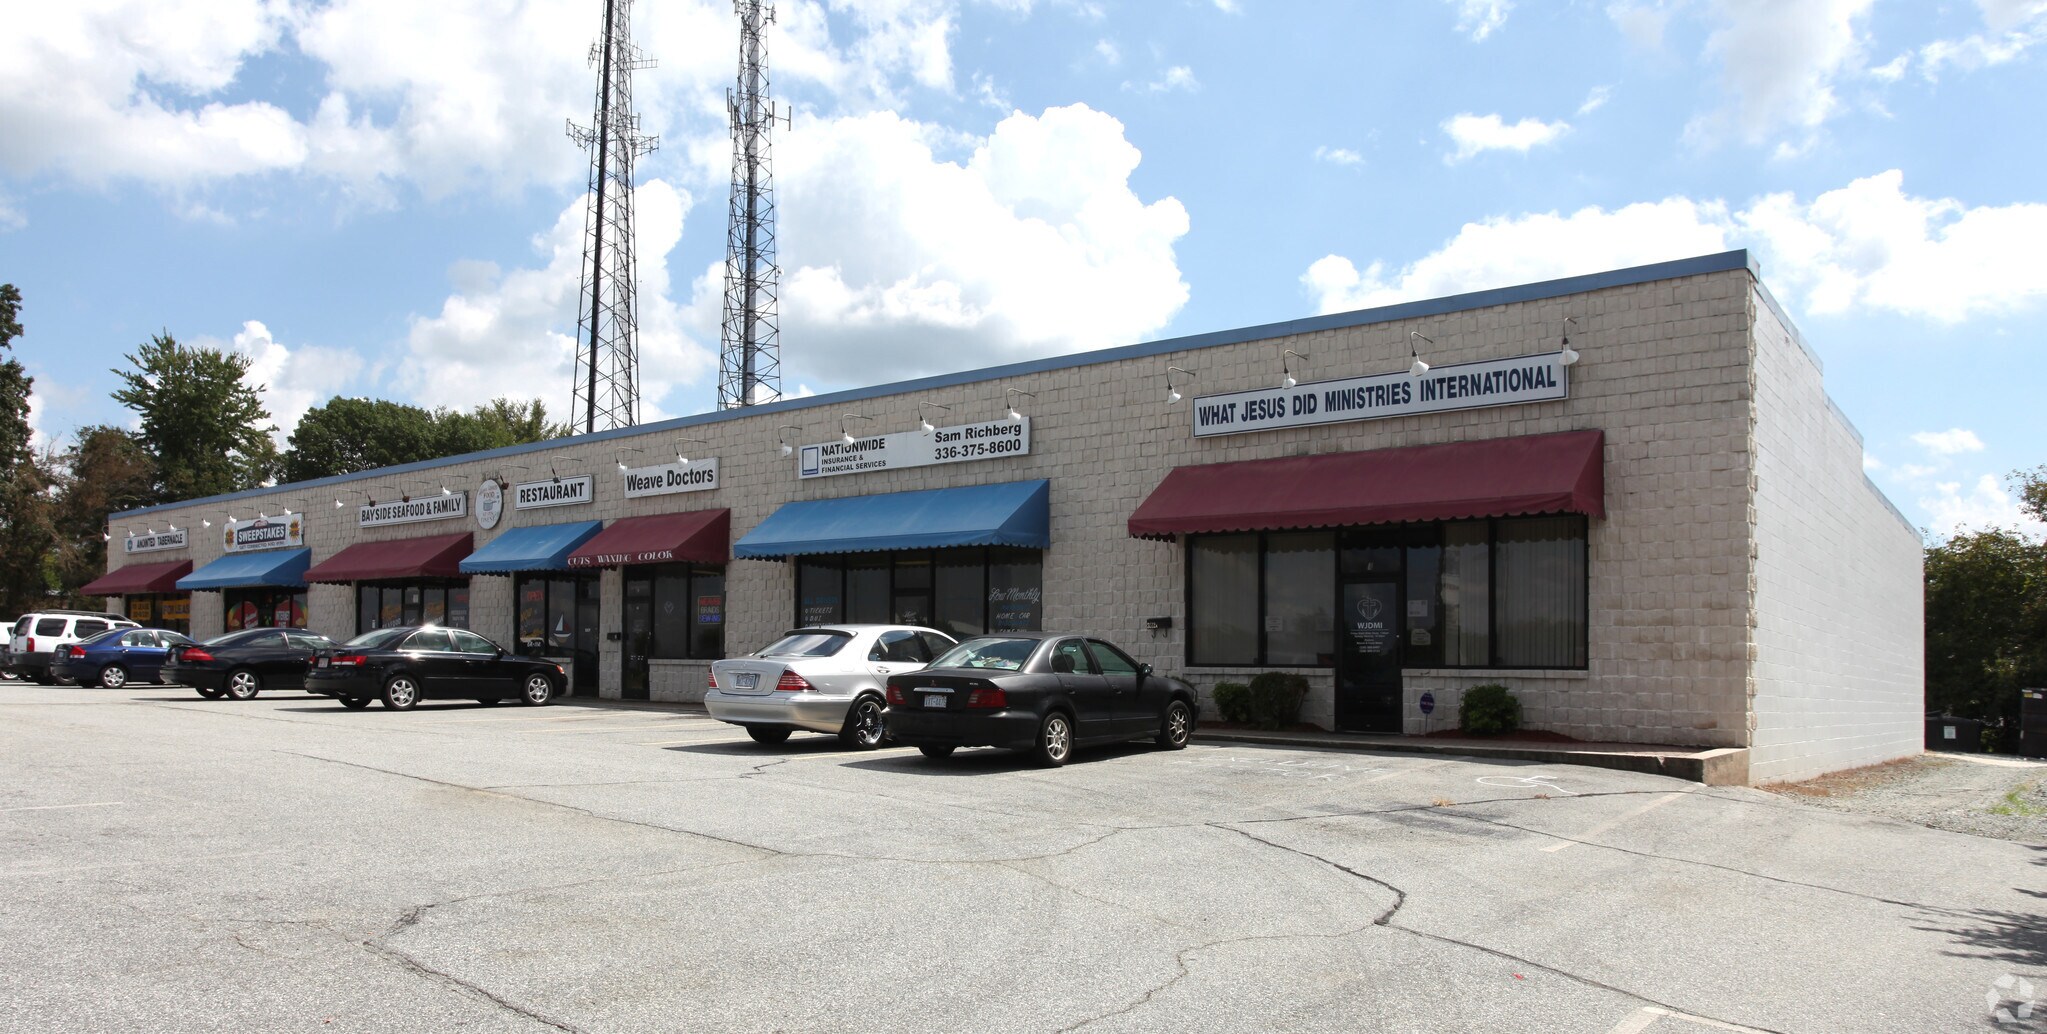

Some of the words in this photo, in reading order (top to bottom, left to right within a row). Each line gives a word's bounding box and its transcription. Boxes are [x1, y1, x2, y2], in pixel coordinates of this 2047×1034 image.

[1199, 403, 1236, 427] WHAT
[1241, 397, 1286, 422] JESUS
[1293, 393, 1317, 416] DID
[1325, 381, 1411, 413] MINISTRIES
[1420, 364, 1557, 401] INTERNATIONAL
[934, 430, 961, 443] Sam
[965, 423, 1022, 440] Richberg
[821, 438, 885, 457] NATIONWIDE
[934, 438, 1021, 460] 336-375-8600
[821, 455, 855, 465] INSURANCE
[856, 454, 864, 462] &
[821, 463, 854, 474] FINANCIAL
[855, 460, 887, 471] SERVICES
[627, 473, 663, 492] Weave
[667, 468, 714, 487] Doctors
[520, 482, 584, 503] RESTAURANT
[361, 505, 392, 522] BAYSIDE
[393, 502, 425, 520] SEAFOOD
[426, 502, 432, 515] &
[433, 498, 462, 513] FAMILY
[136, 537, 155, 549] ANOINTED
[157, 534, 183, 546] TABERNACLE
[238, 526, 285, 543] SWEEPSTAKES
[567, 556, 590, 566] CUTS
[597, 553, 632, 563] WAXING
[638, 550, 673, 561] COLOR
[1006, 587, 1040, 604] Monthly
[174, 602, 190, 614] LEAS
[809, 606, 833, 614] TICKETS
